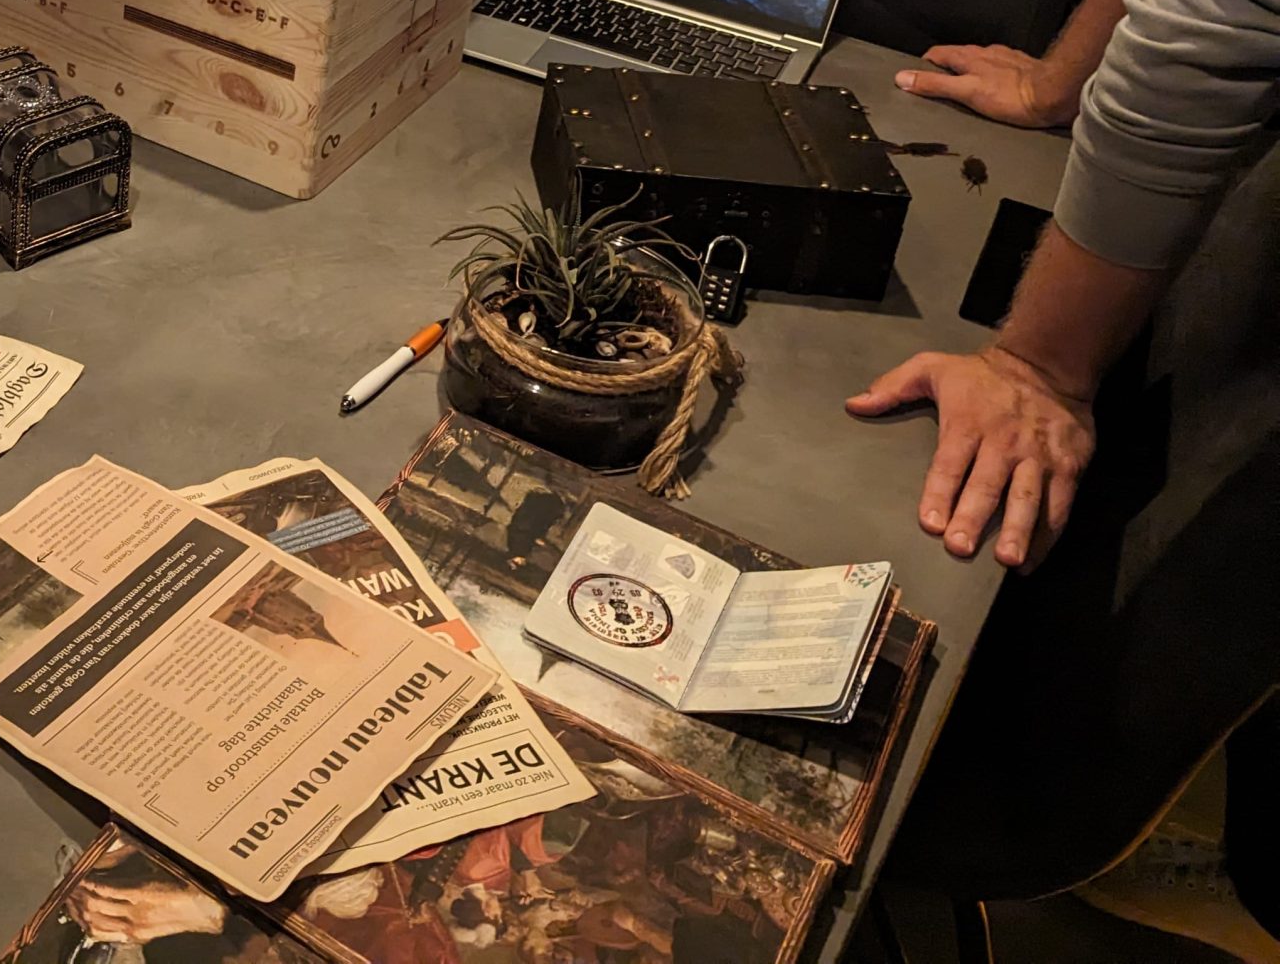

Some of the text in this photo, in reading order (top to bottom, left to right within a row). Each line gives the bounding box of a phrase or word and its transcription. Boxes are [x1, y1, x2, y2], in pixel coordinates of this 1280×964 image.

[184, 553, 198, 563] en
[141, 561, 190, 598] aangeboden
[108, 581, 150, 613] eventuele
[130, 597, 148, 610] aan
[25, 547, 224, 716] In het verleden zijn vaker doeken van Van Gogh gestolen
[71, 610, 116, 644] strafzaken
[46, 642, 77, 666] wilden
[68, 654, 83, 665] de
[77, 643, 96, 656] die
[45, 662, 73, 684] kunst
[33, 682, 50, 694] als
[241, 676, 308, 734] klaarlichte
[341, 658, 452, 756] Tableau
[428, 694, 470, 731] NIEUWS
[500, 712, 521, 723] HET
[202, 687, 326, 793] Brutale kunstroof op
[215, 728, 249, 754] dag
[369, 741, 547, 813] DE KRANT
[481, 778, 515, 796] maar
[512, 775, 529, 786] zo
[527, 768, 555, 784] Niet
[227, 748, 350, 862] nouveau
[459, 787, 484, 802] een
